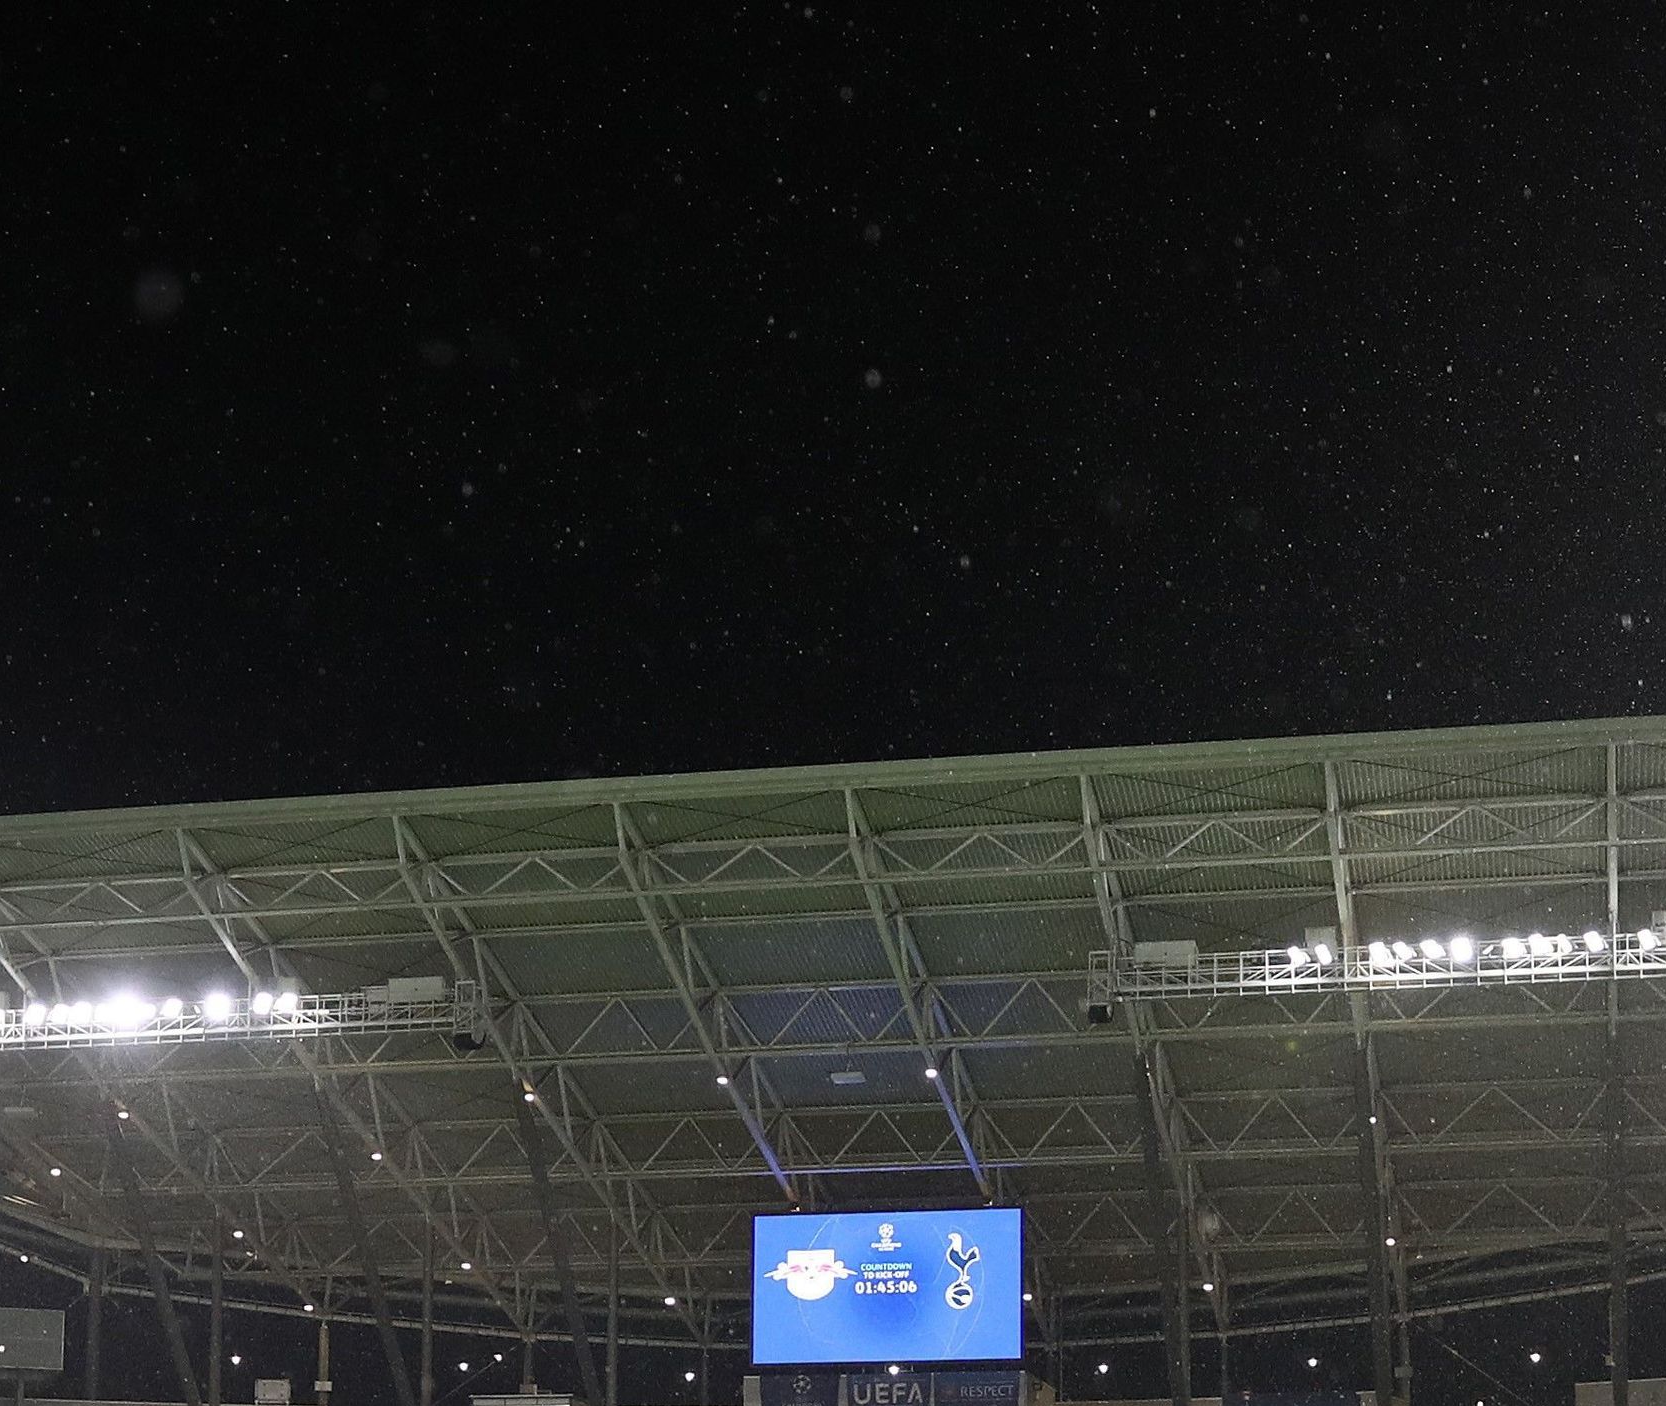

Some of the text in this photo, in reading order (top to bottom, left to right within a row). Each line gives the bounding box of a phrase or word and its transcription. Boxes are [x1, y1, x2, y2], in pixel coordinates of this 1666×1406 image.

[860, 1263, 913, 1271] COUNTDOWN
[863, 1270, 910, 1279] TO KICK-OFF
[855, 1280, 917, 1294] 01:45:06
[853, 1382, 923, 1405] UEFA
[960, 1385, 1014, 1397] RESPECT
